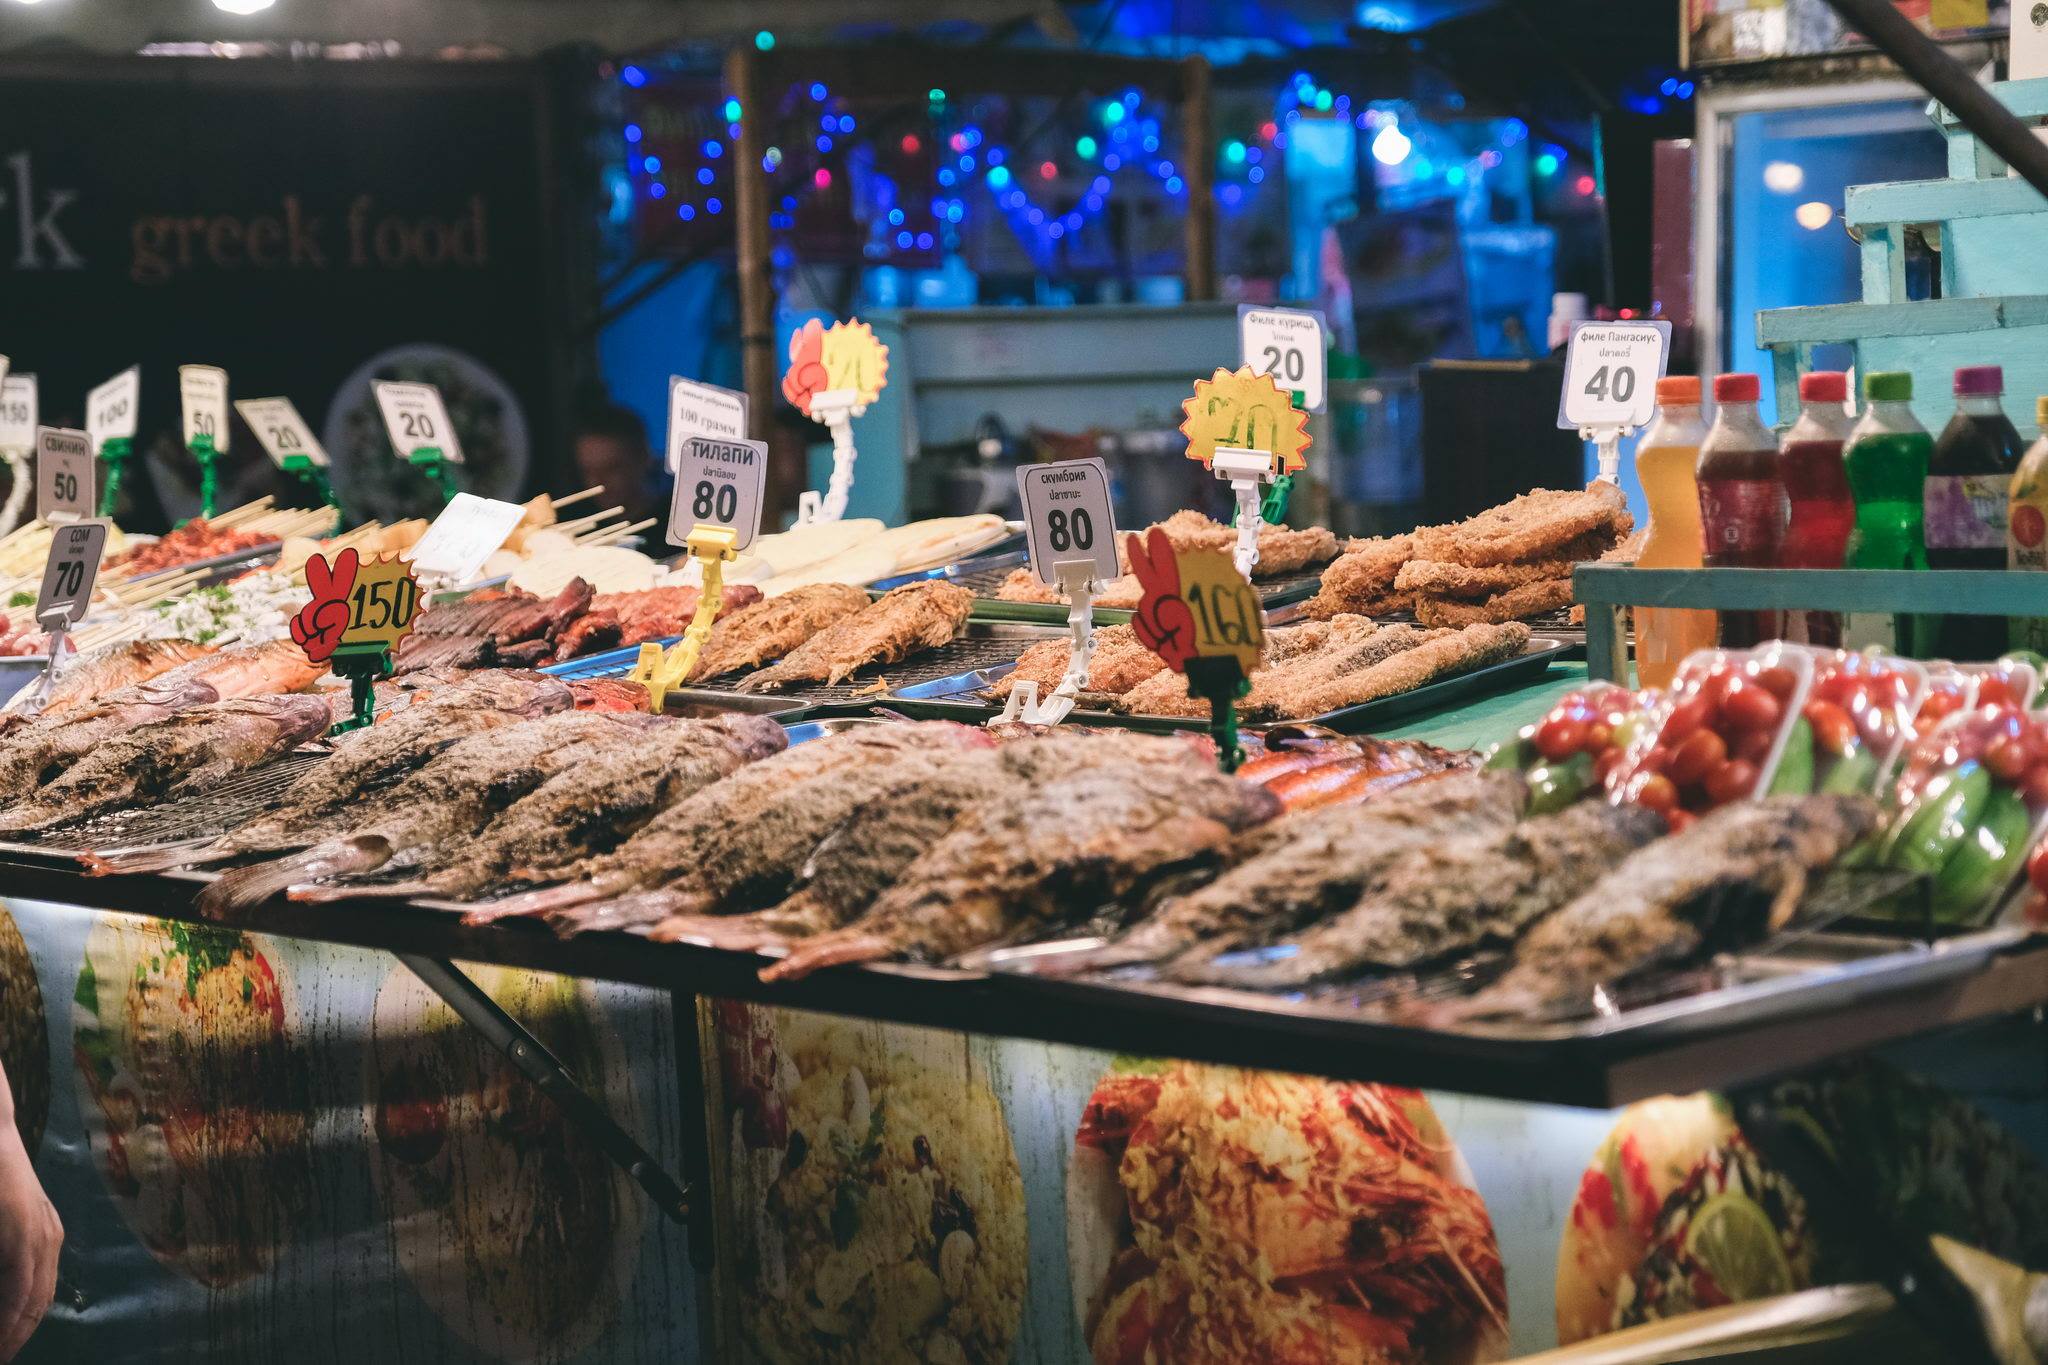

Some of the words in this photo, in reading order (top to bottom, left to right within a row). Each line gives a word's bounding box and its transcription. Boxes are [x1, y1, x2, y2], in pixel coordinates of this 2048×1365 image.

[0, 152, 83, 269] k
[131, 193, 326, 284] greek
[345, 193, 490, 268] food
[1263, 346, 1304, 381] 20
[1584, 365, 1636, 403] 40
[268, 425, 302, 448] 20
[399, 412, 434, 439] 20
[54, 472, 77, 502] 50
[692, 480, 738, 523] 80
[1047, 507, 1094, 552] 80
[53, 560, 84, 598] 70
[348, 576, 416, 630] 150
[1188, 583, 1263, 645] 160
